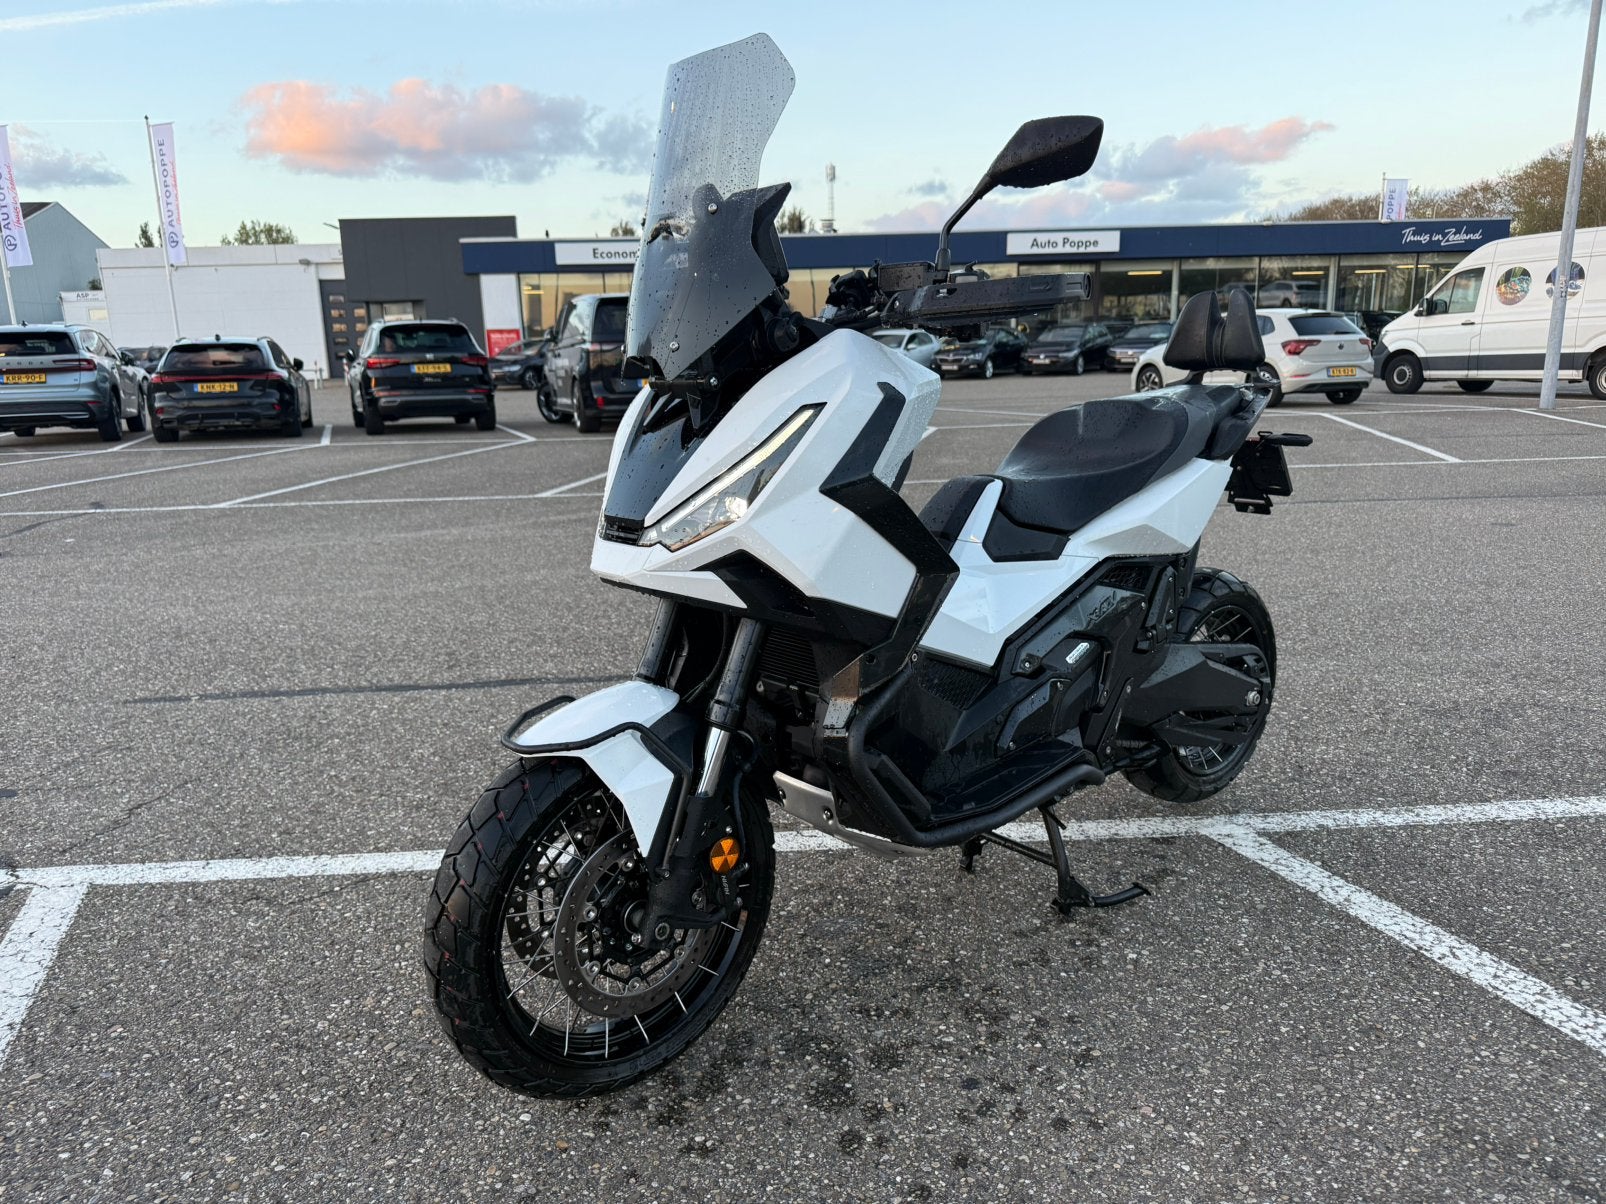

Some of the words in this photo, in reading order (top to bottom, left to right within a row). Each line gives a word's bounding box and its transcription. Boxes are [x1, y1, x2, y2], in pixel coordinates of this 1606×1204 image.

[157, 138, 175, 228] AUTOPOPPE
[1030, 238, 1058, 249] Auto
[1062, 237, 1099, 250] Poppe
[1401, 227, 1430, 244] Thuis
[1432, 232, 1444, 241] in
[1441, 225, 1482, 246] Zeeland
